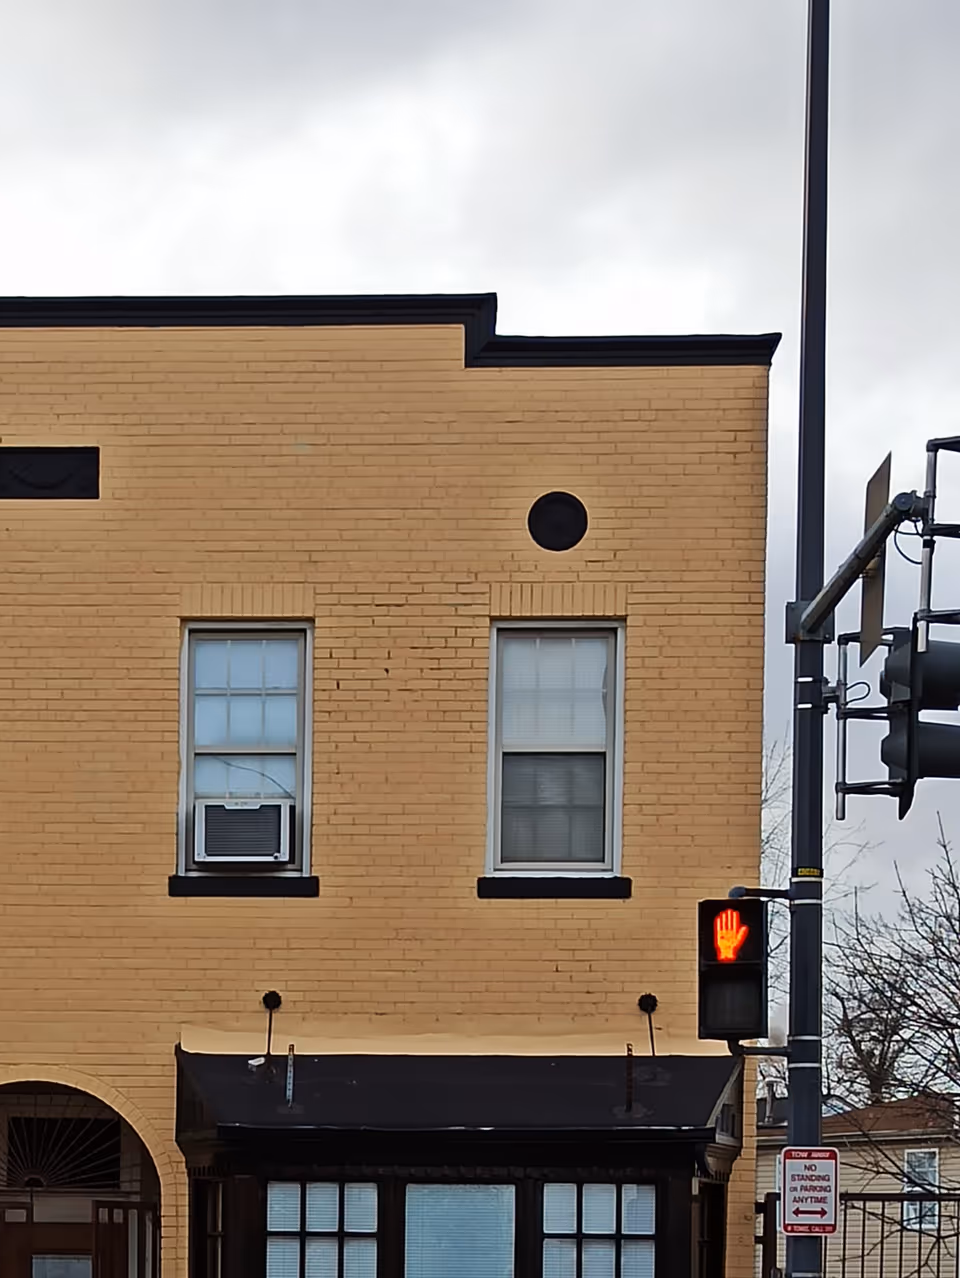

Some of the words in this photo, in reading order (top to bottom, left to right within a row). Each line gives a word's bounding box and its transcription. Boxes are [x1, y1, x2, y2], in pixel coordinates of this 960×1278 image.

[803, 1164, 817, 1172] NO
[791, 1174, 830, 1182] STANDING
[800, 1185, 831, 1193] PARKING
[792, 1196, 828, 1204] ANYTIME
